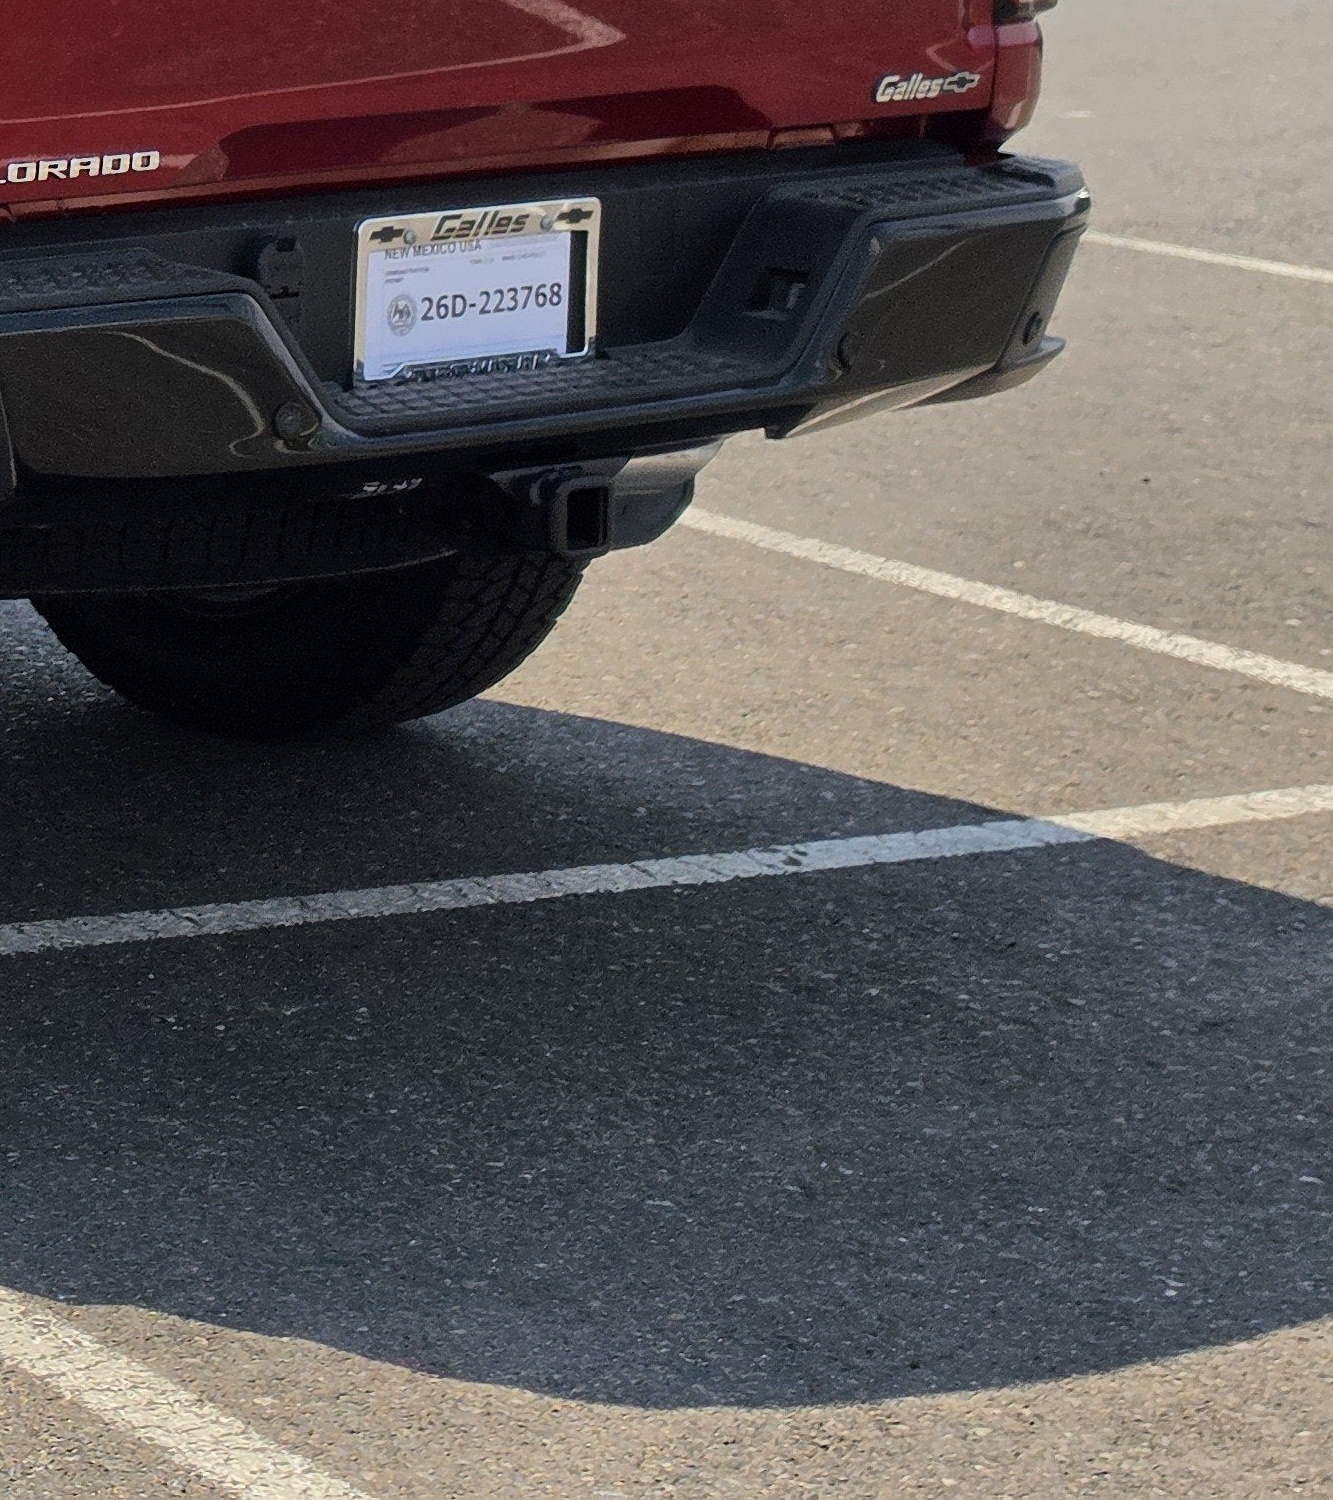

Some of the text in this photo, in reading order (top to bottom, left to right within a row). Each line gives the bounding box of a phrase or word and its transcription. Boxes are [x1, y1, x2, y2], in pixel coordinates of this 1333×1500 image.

[875, 72, 944, 103] Galles
[430, 209, 531, 241] Galles
[420, 282, 563, 322] 26D-223768
